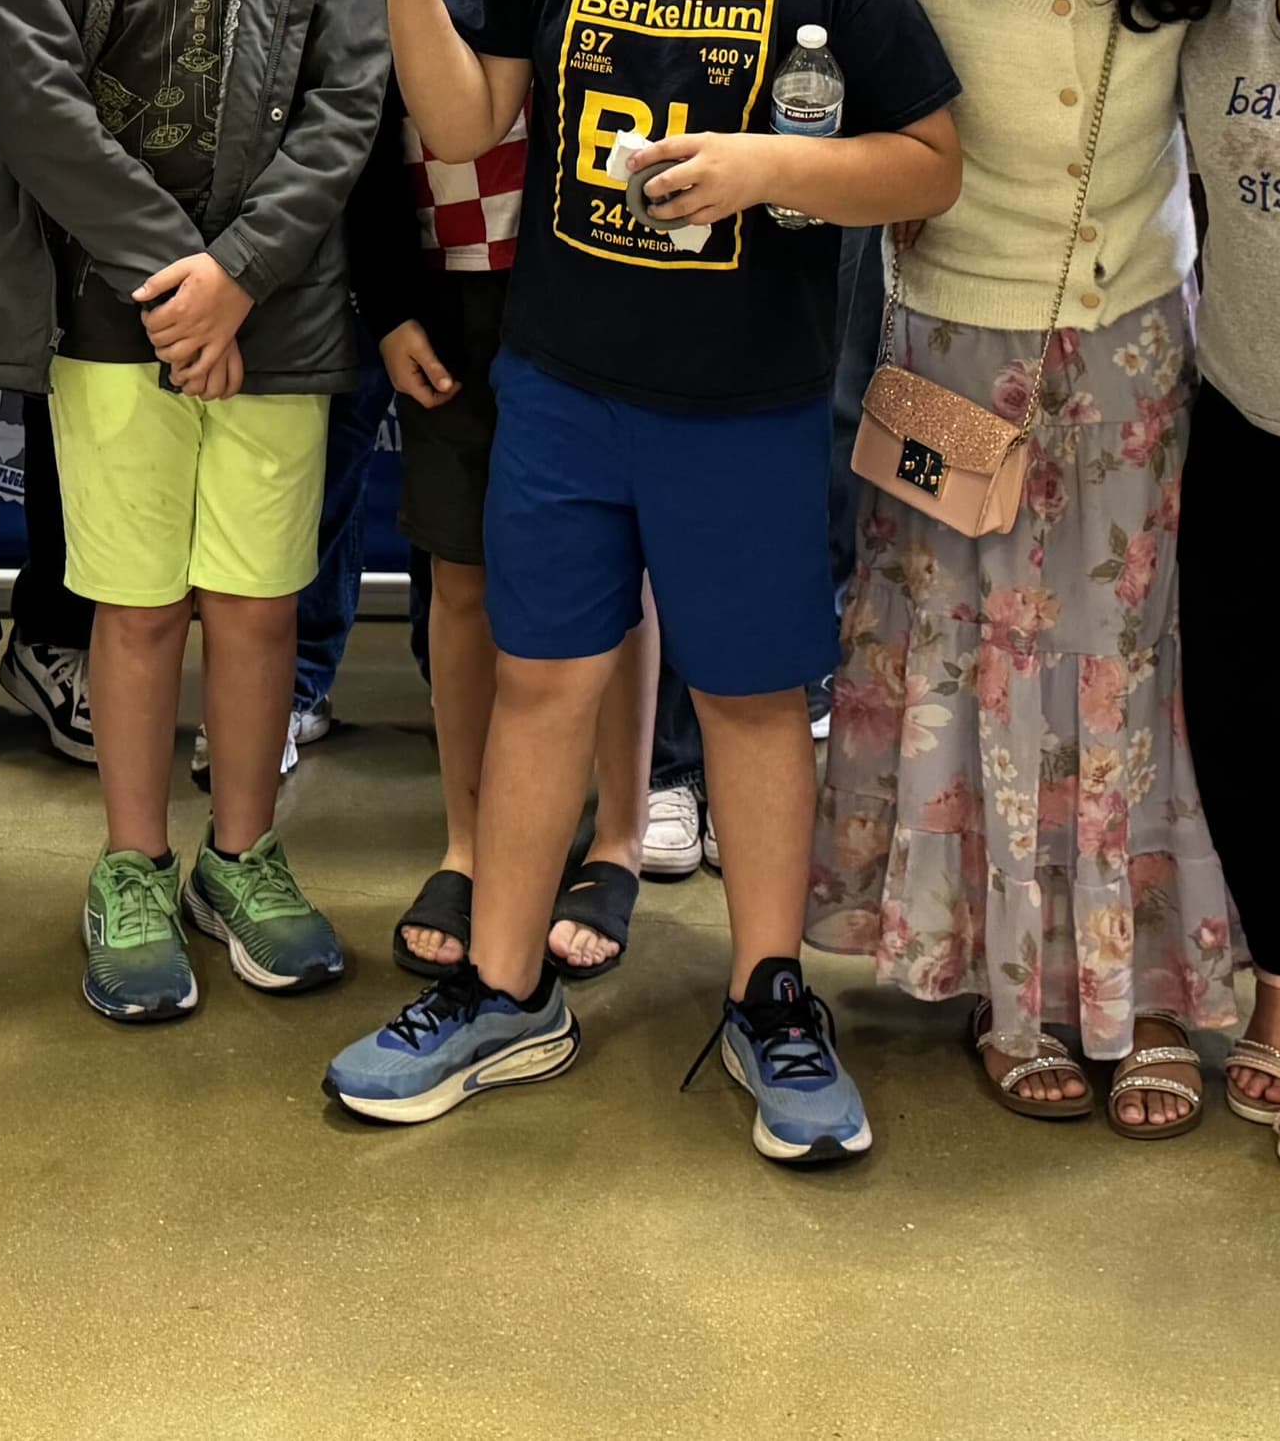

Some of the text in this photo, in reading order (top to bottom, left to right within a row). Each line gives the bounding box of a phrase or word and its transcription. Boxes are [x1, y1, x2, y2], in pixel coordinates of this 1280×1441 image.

[579, 28, 614, 54] 97
[574, 51, 612, 65] ATOMIC
[699, 47, 754, 69] 1400 y
[570, 59, 613, 74] NUMBER
[707, 66, 734, 77] HALF
[709, 75, 730, 86] LIFE
[591, 228, 683, 252] ATOMIC WEIGH
